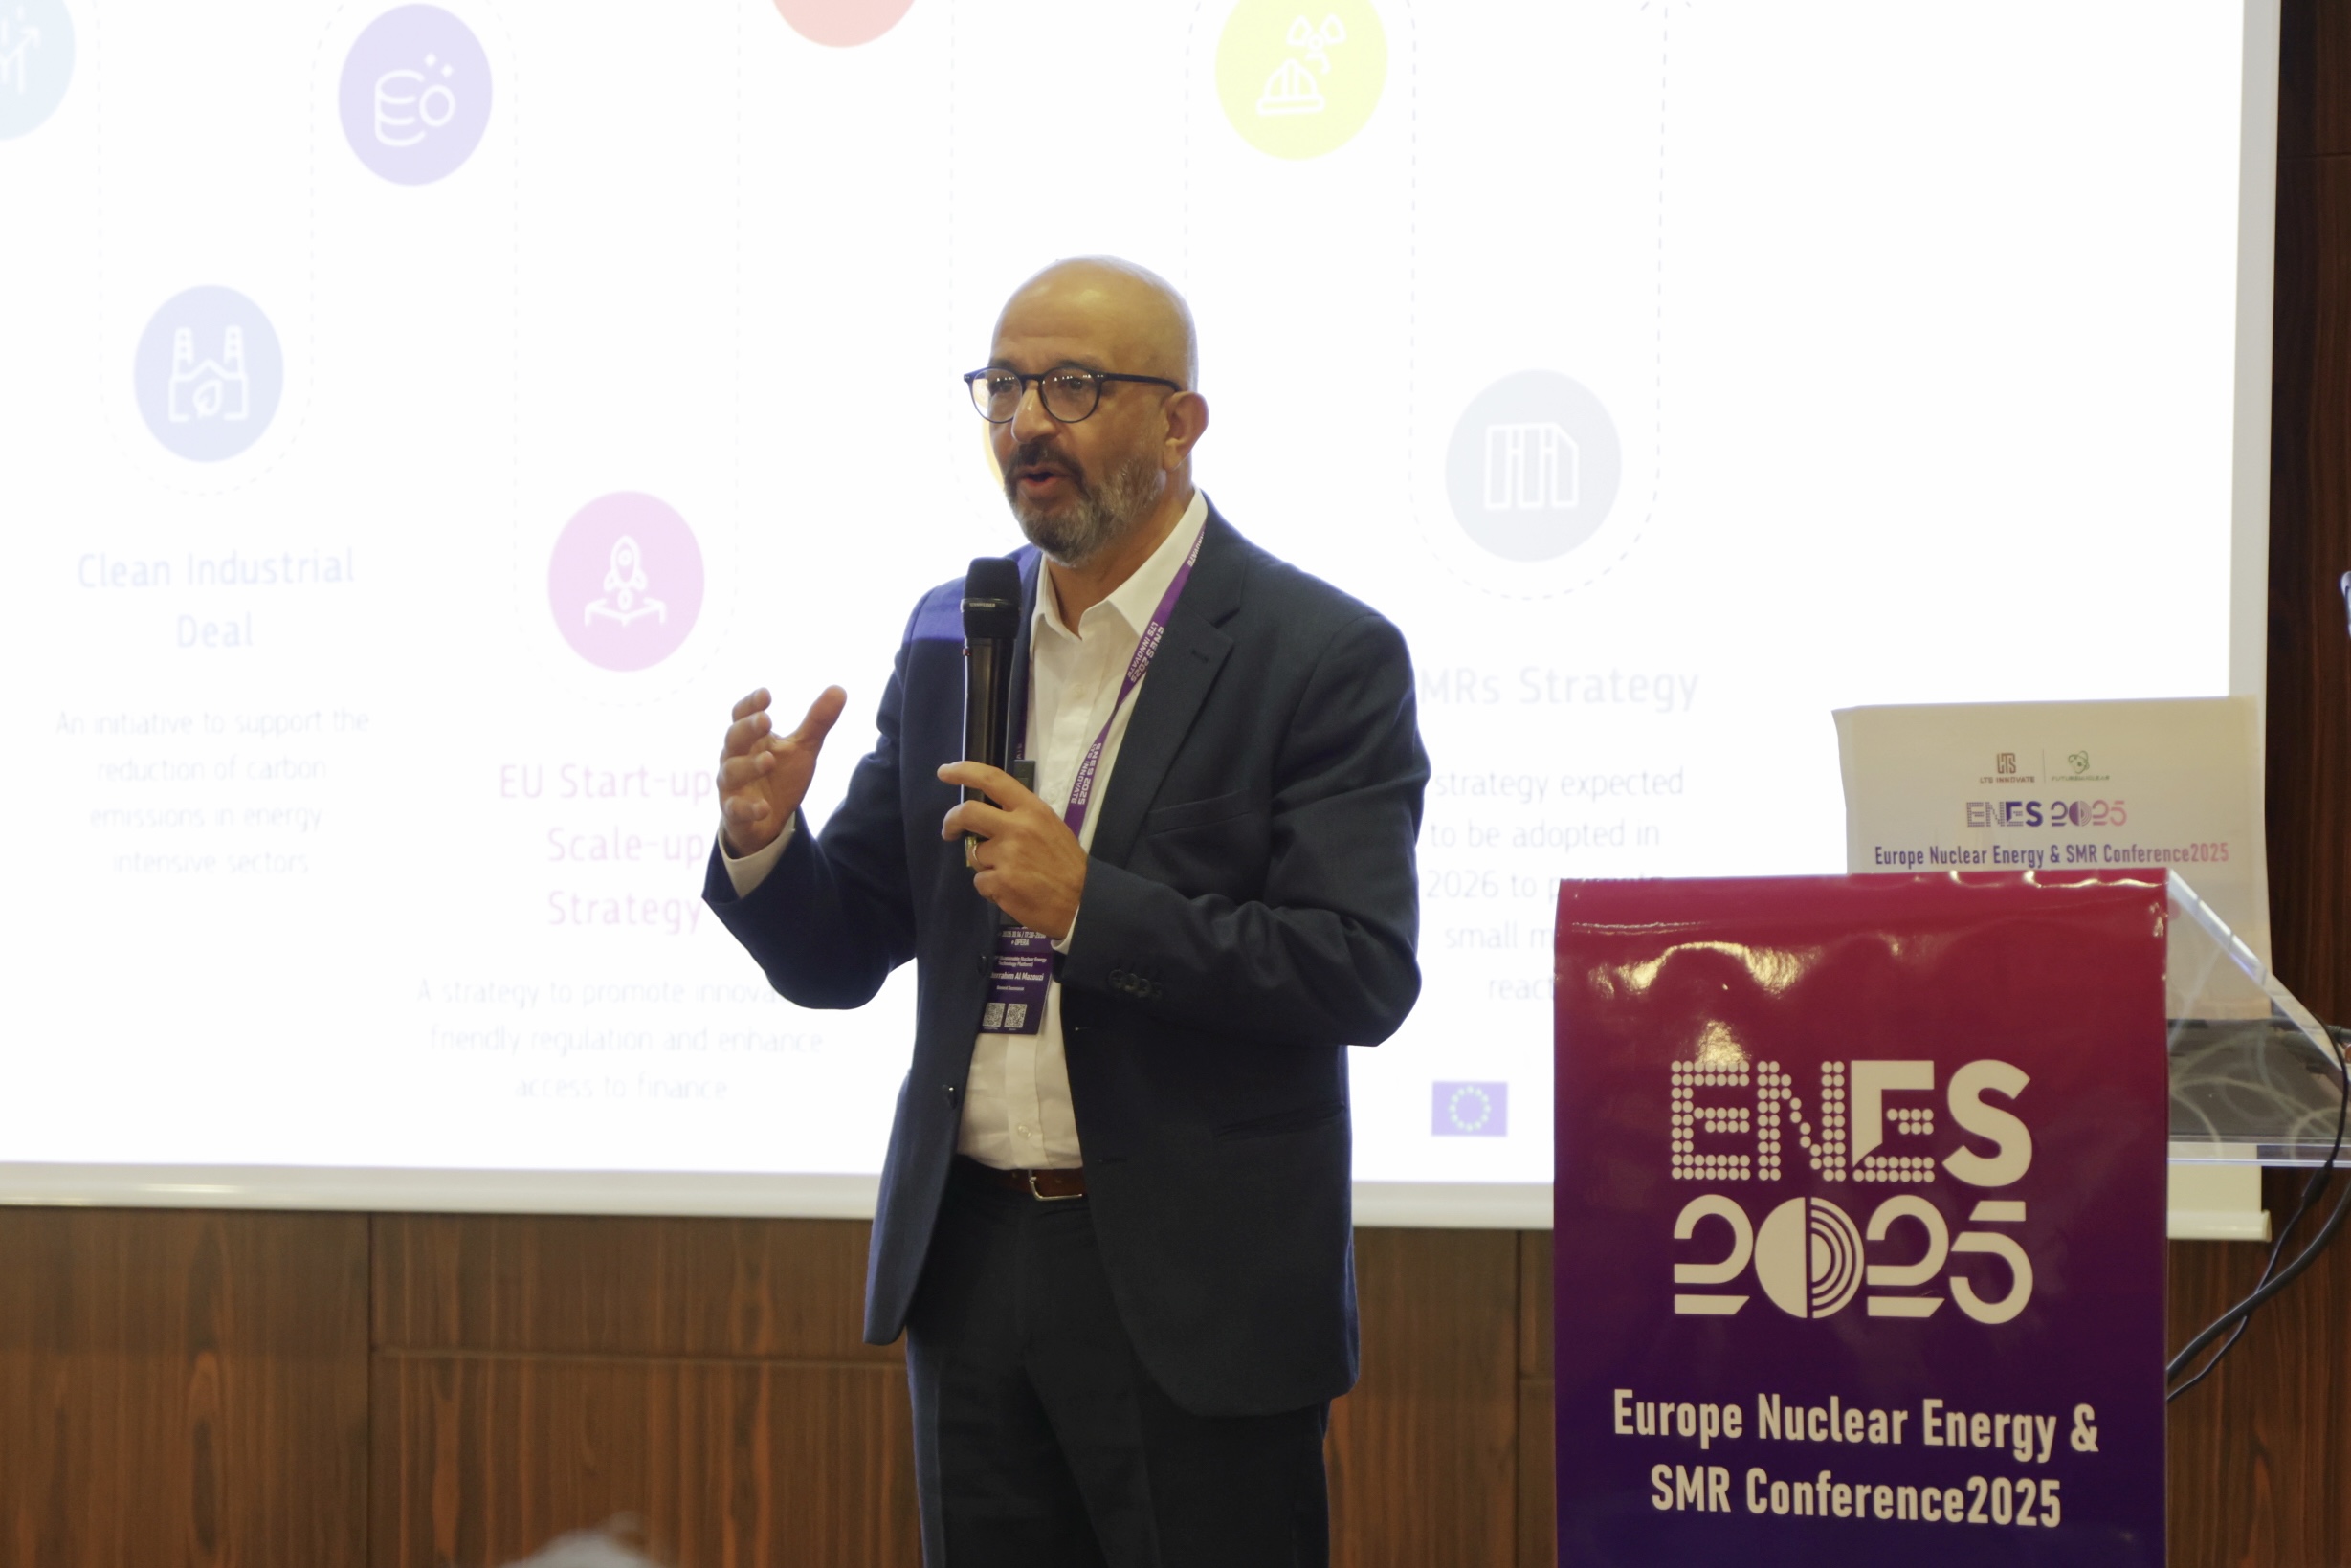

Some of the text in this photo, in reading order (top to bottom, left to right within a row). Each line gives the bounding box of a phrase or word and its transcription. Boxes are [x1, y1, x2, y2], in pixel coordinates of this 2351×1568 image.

[77, 545, 355, 588] Clean Industrial
[176, 610, 254, 649] Deal
[1127, 636, 1151, 678] INNOVATE
[1130, 626, 1164, 683] ENES 2025
[1419, 665, 1700, 714] MRs Strategy
[55, 707, 369, 740] An initiative to support the
[97, 754, 327, 781] reduction of carbon
[1997, 753, 2016, 774] LTS
[499, 763, 713, 806] EU Start-up
[1077, 777, 1092, 806] 2025
[1435, 765, 1684, 805] strategy expected
[90, 806, 323, 833] emissions in energy
[1966, 800, 2127, 827] ENES 2025
[547, 826, 706, 870] Scale-up
[1431, 818, 1660, 854] to be adopted in
[113, 851, 309, 873] intensive sectors
[1874, 843, 2229, 870] Europe Nuclear Energy & SMR Conference2025
[1426, 869, 1499, 899] 2026
[1511, 873, 1538, 898] to
[547, 890, 704, 935] Strategy
[1445, 920, 1518, 949] small
[417, 978, 777, 1009] A strategy to promote innova
[1488, 976, 1554, 1001] react
[431, 1024, 825, 1057] friendly regulation and enhance
[515, 1071, 727, 1100] access to finance
[1671, 1057, 2033, 1188] ENES
[1673, 1194, 2034, 1326] 2025
[1613, 1388, 2100, 1465] Europe Nuclear Energy &
[1651, 1463, 2062, 1529] SMR Conference2025
